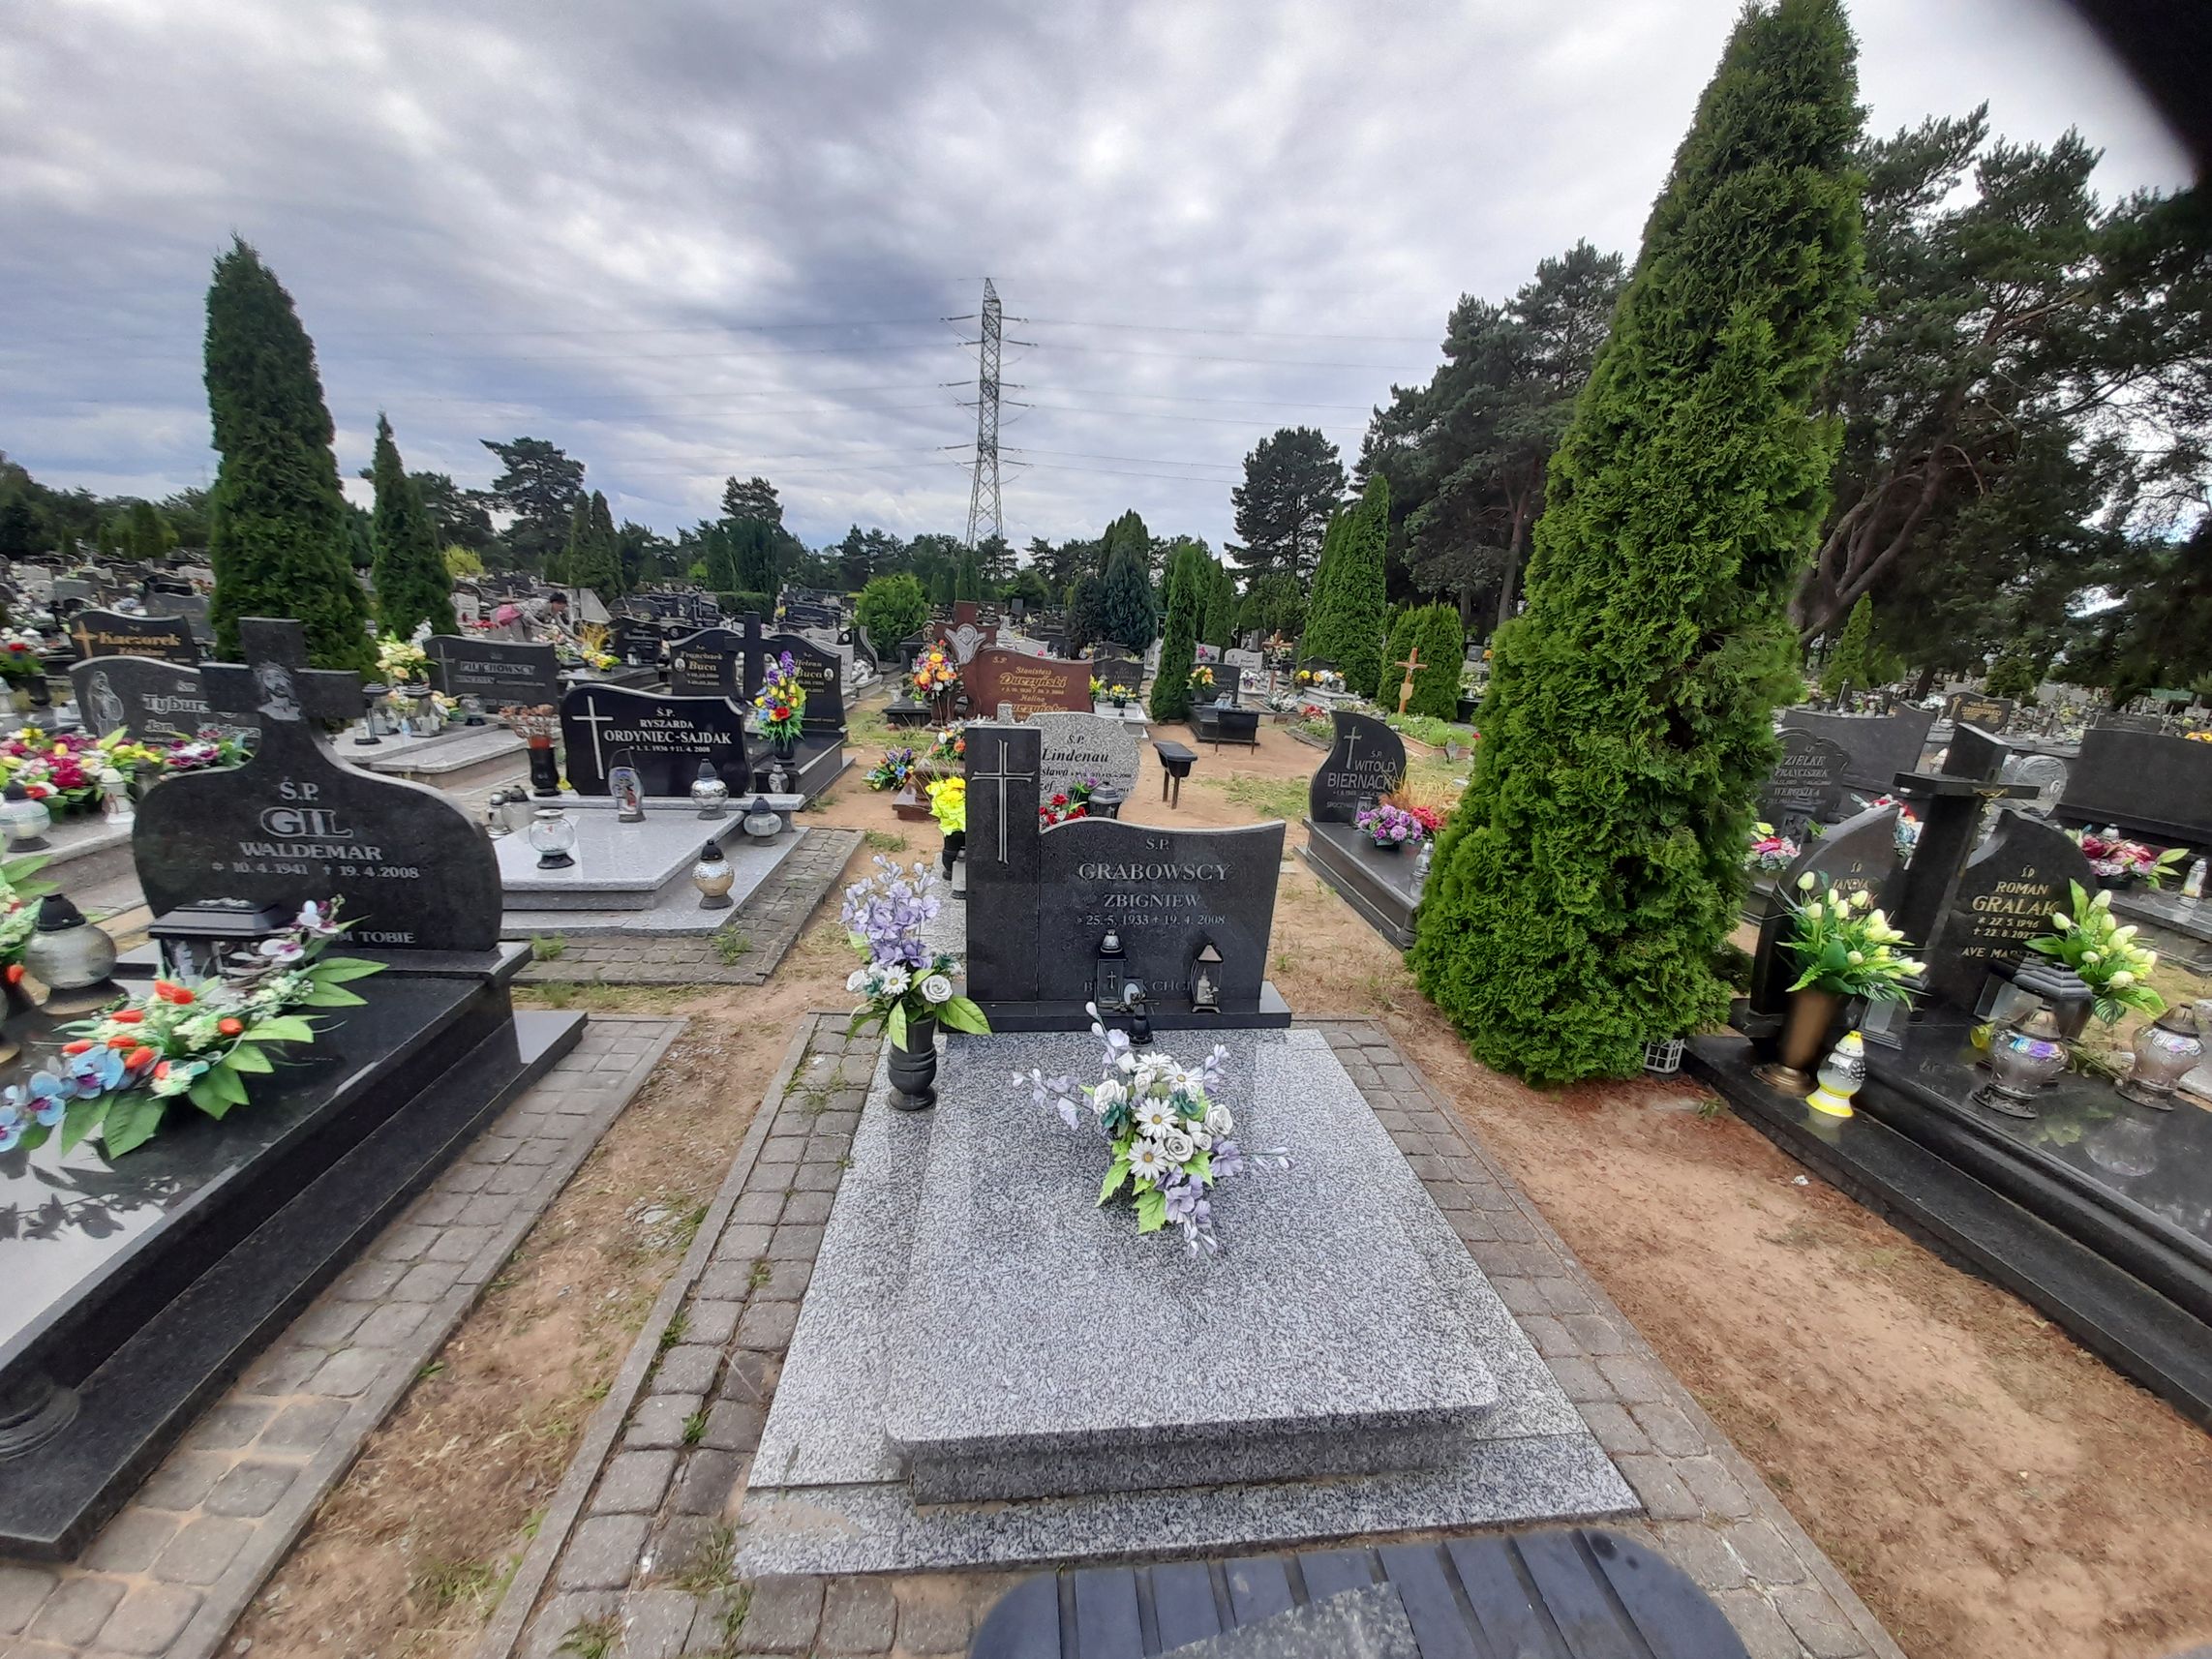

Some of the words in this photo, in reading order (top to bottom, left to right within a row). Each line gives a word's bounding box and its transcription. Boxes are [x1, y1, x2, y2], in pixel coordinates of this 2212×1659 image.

[999, 672, 1069, 688] Duczyński
[639, 719, 694, 729] RYSZARDA
[604, 729, 732, 744] ORDYNIEC-SAJDAK
[1042, 748, 1109, 763] Lindenau
[1355, 760, 1395, 772] WITOLD
[259, 806, 354, 838] GIL
[240, 841, 383, 860] WALDEMAR
[1078, 862, 1232, 881] GRABOWSCY
[1995, 882, 2049, 895] ROMAN
[1104, 893, 1202, 908] ZBIGNIEW
[1972, 895, 2059, 917] GRALAK
[1197, 915, 1226, 925] 2008
[359, 931, 415, 944] TOBIE
[1961, 947, 1986, 957] AVE
